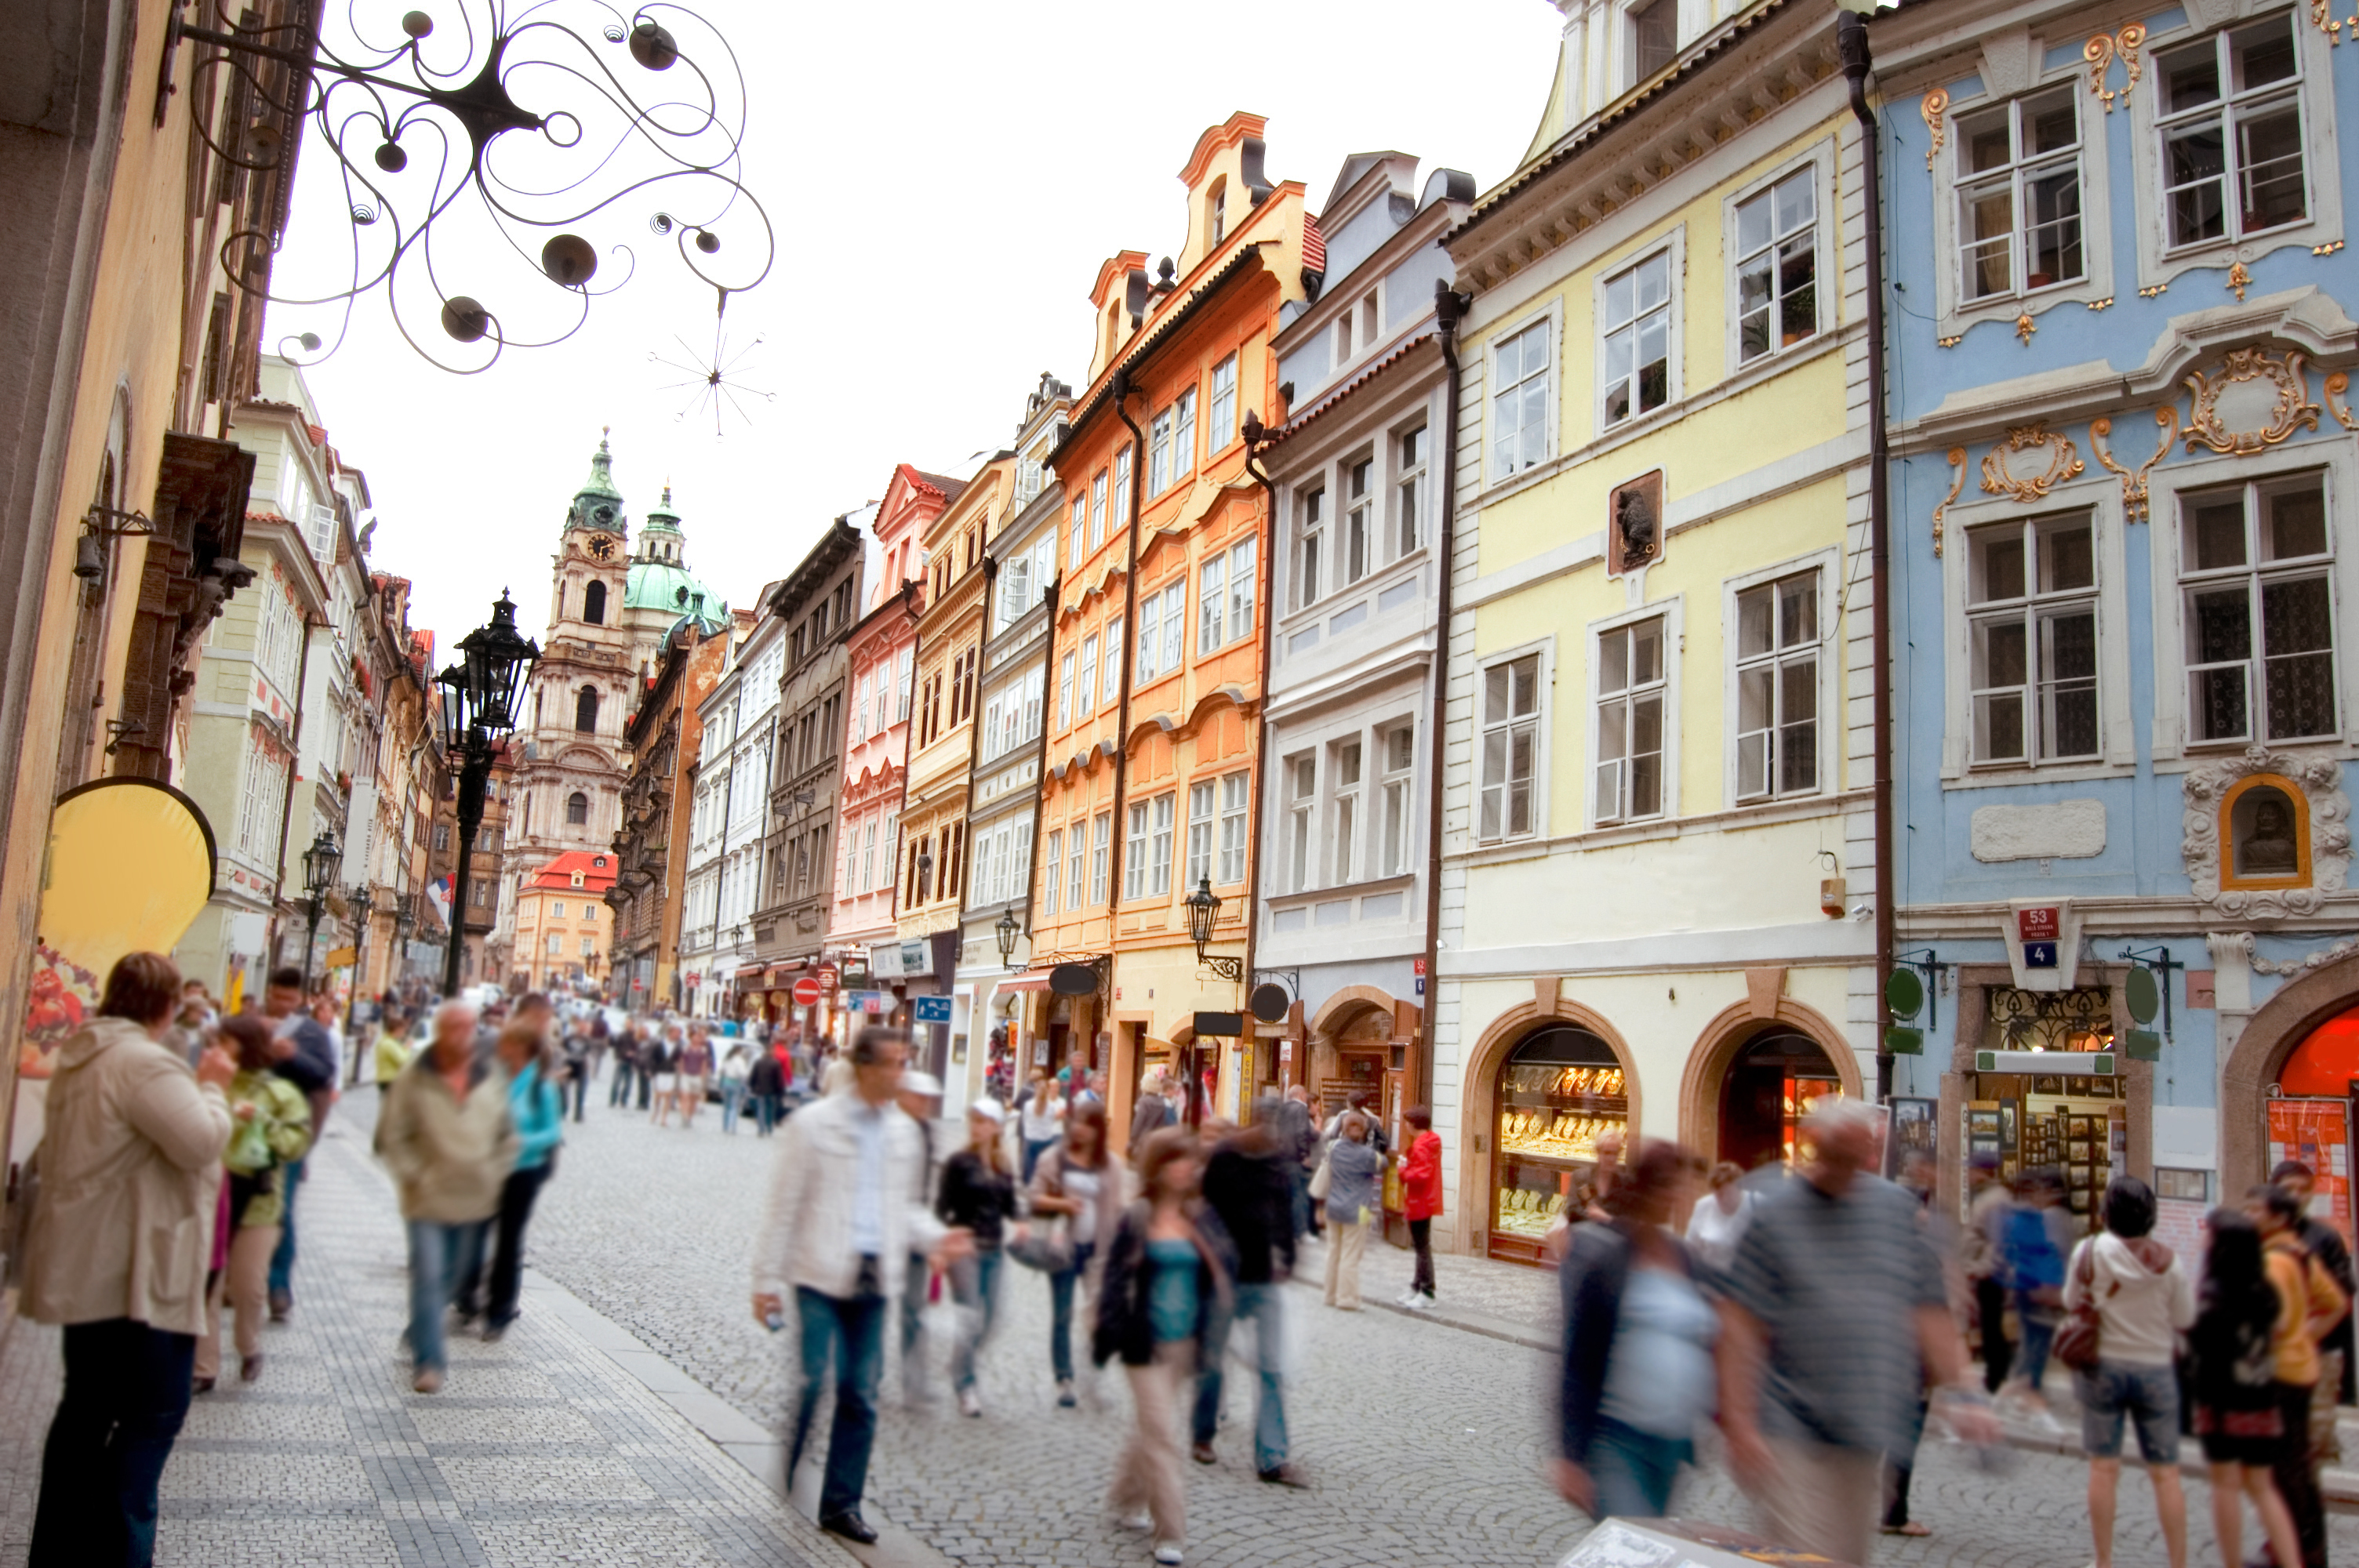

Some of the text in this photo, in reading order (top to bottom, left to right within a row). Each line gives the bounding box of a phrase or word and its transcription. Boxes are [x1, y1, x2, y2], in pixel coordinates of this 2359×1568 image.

[303, 724, 318, 769] DOMUS
[2030, 909, 2048, 924] 53
[2034, 947, 2045, 962] 4
[1418, 981, 1423, 991] 6
